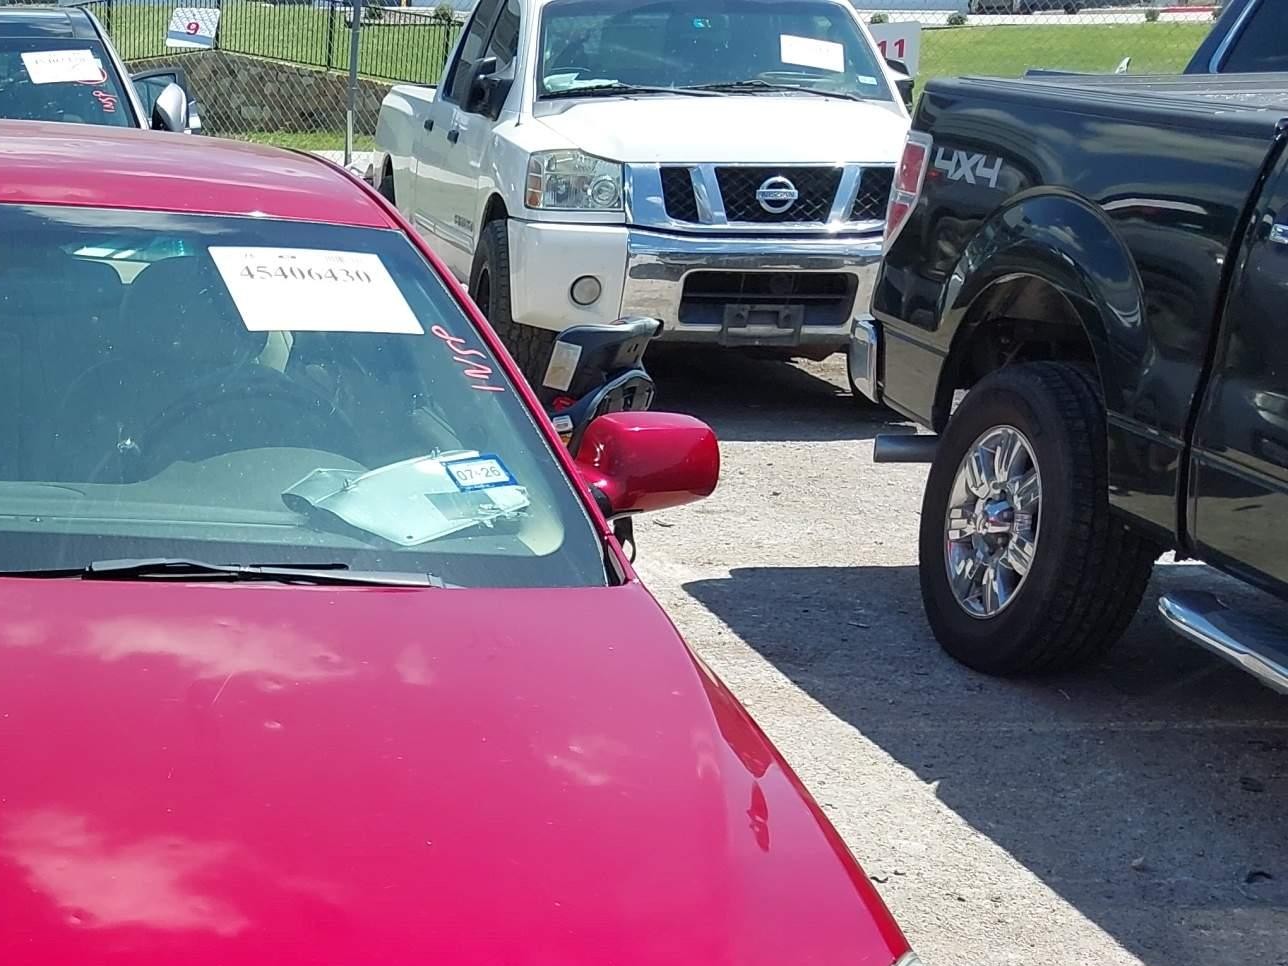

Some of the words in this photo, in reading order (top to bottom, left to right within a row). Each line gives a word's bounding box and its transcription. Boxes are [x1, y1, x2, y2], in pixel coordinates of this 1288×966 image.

[186, 21, 200, 36] 9
[877, 38, 905, 59] 11
[934, 147, 1003, 188] 4X4
[240, 264, 373, 284] 45406430
[456, 465, 502, 481] 07-26
